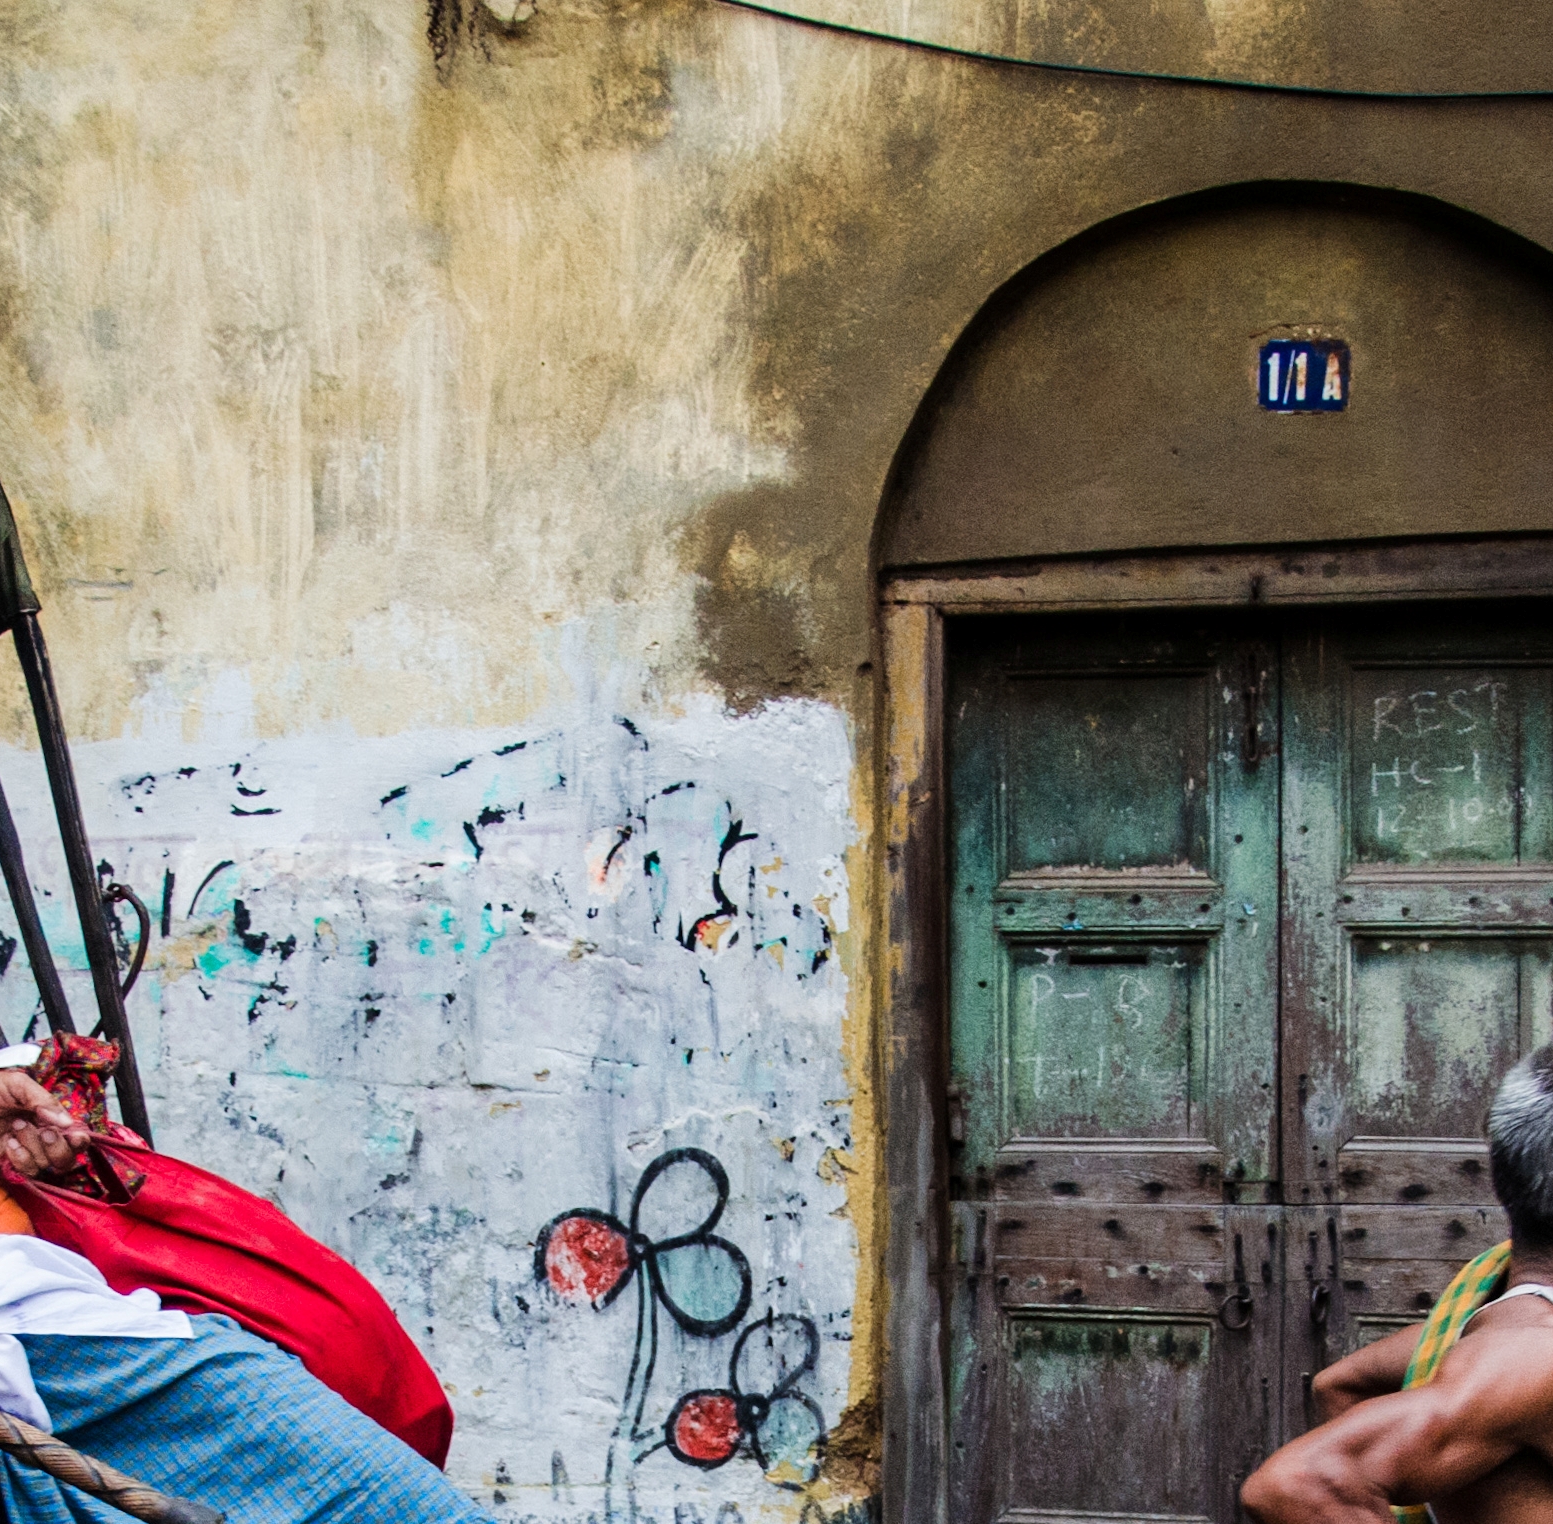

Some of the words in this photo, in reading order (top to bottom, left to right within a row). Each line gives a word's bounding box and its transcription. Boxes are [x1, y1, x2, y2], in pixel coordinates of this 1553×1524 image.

[1267, 350, 1308, 405] 1/1
[1321, 352, 1342, 401] A
[1372, 682, 1508, 742] REST
